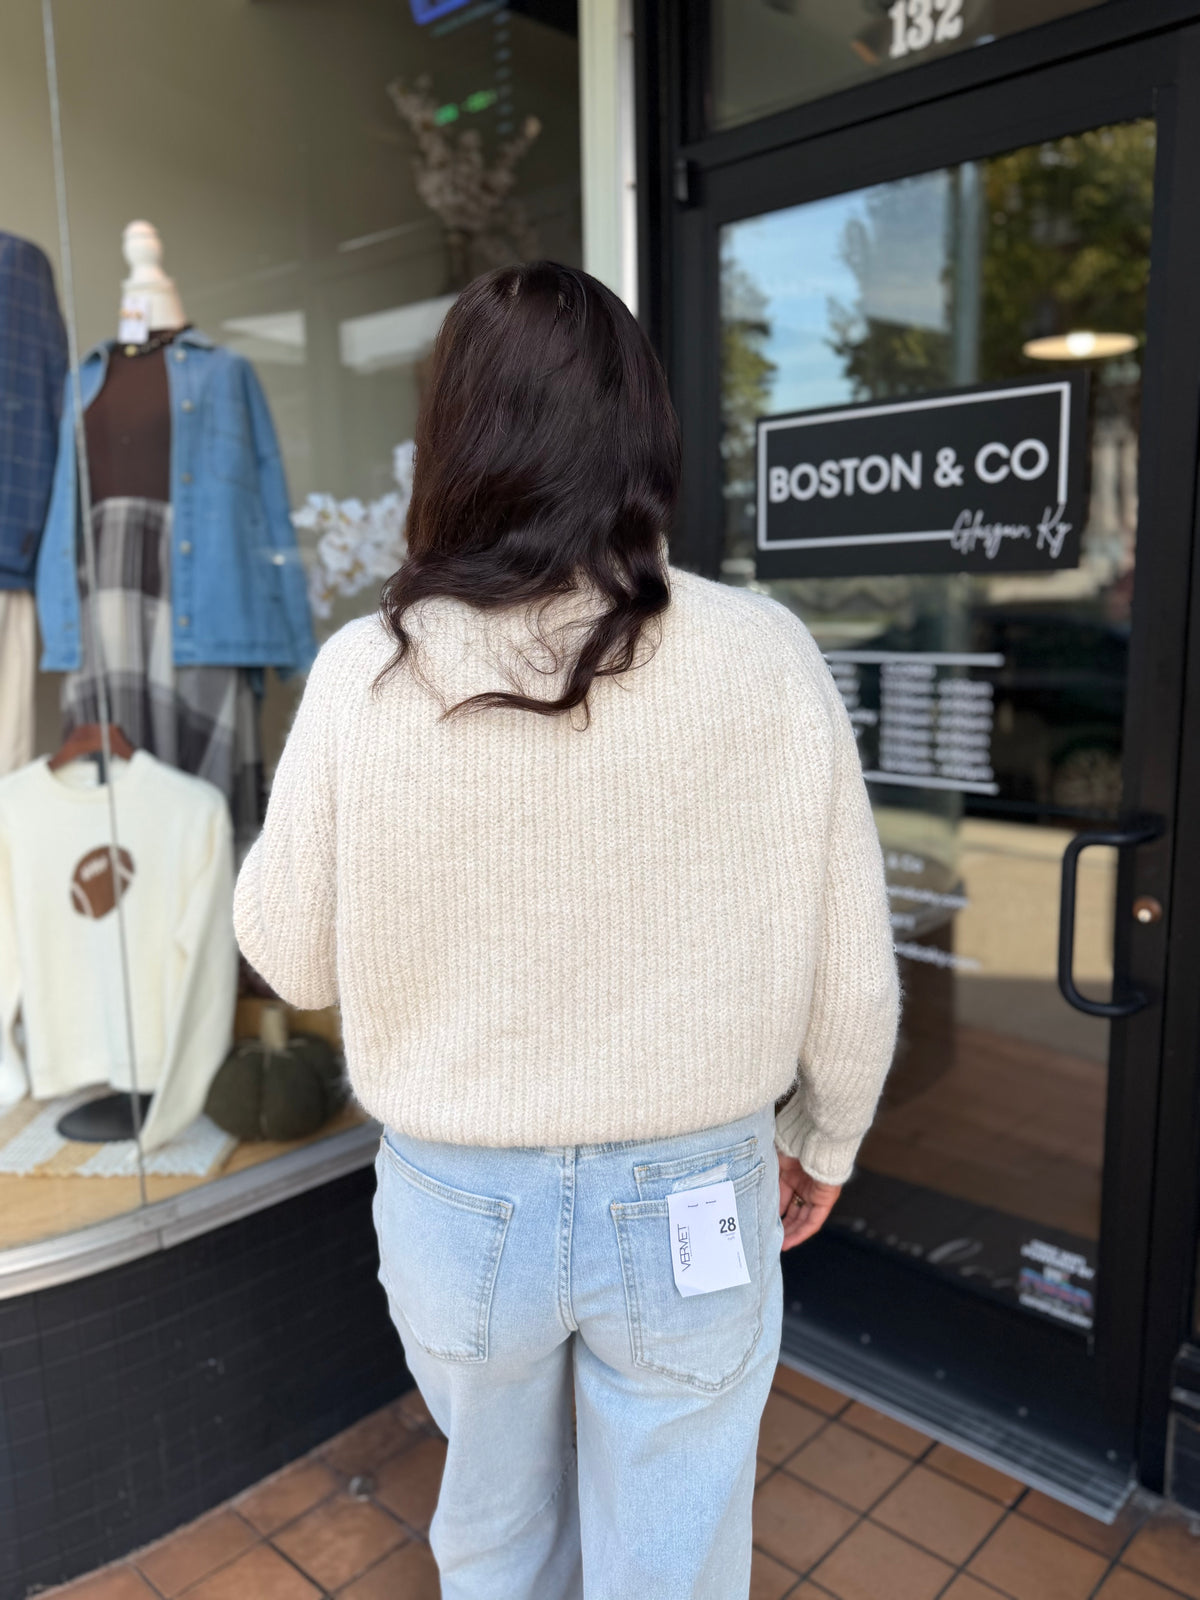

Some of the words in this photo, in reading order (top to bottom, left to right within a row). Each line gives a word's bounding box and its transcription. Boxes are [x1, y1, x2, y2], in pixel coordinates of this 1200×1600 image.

[888, 0, 964, 59] 132
[768, 450, 922, 503] BOSTON
[933, 446, 965, 488] &
[974, 437, 1050, 484] CO
[677, 1223, 691, 1272] VERVET
[719, 1216, 737, 1234] 28
